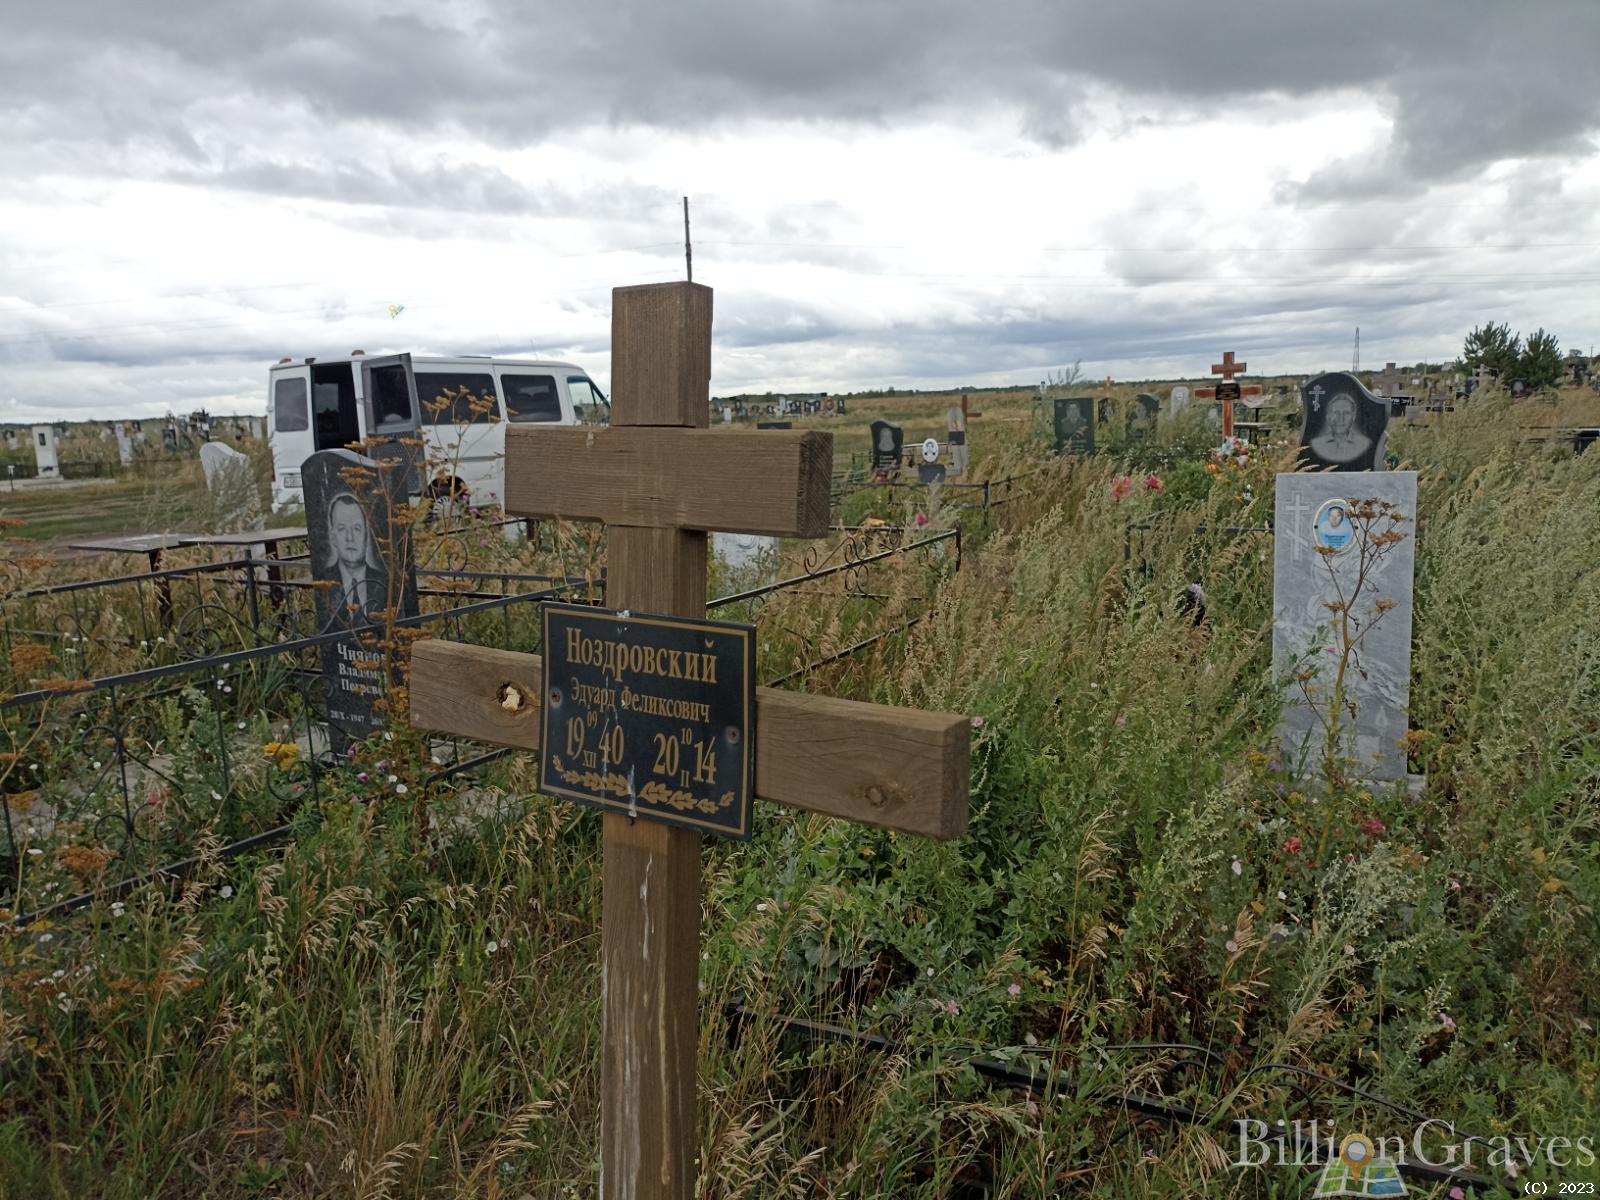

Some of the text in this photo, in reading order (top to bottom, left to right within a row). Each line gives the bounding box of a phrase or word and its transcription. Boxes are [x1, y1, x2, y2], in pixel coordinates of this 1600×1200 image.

[566, 627, 717, 684] Ноздровский
[570, 677, 710, 723] Эдуард Феликсович
